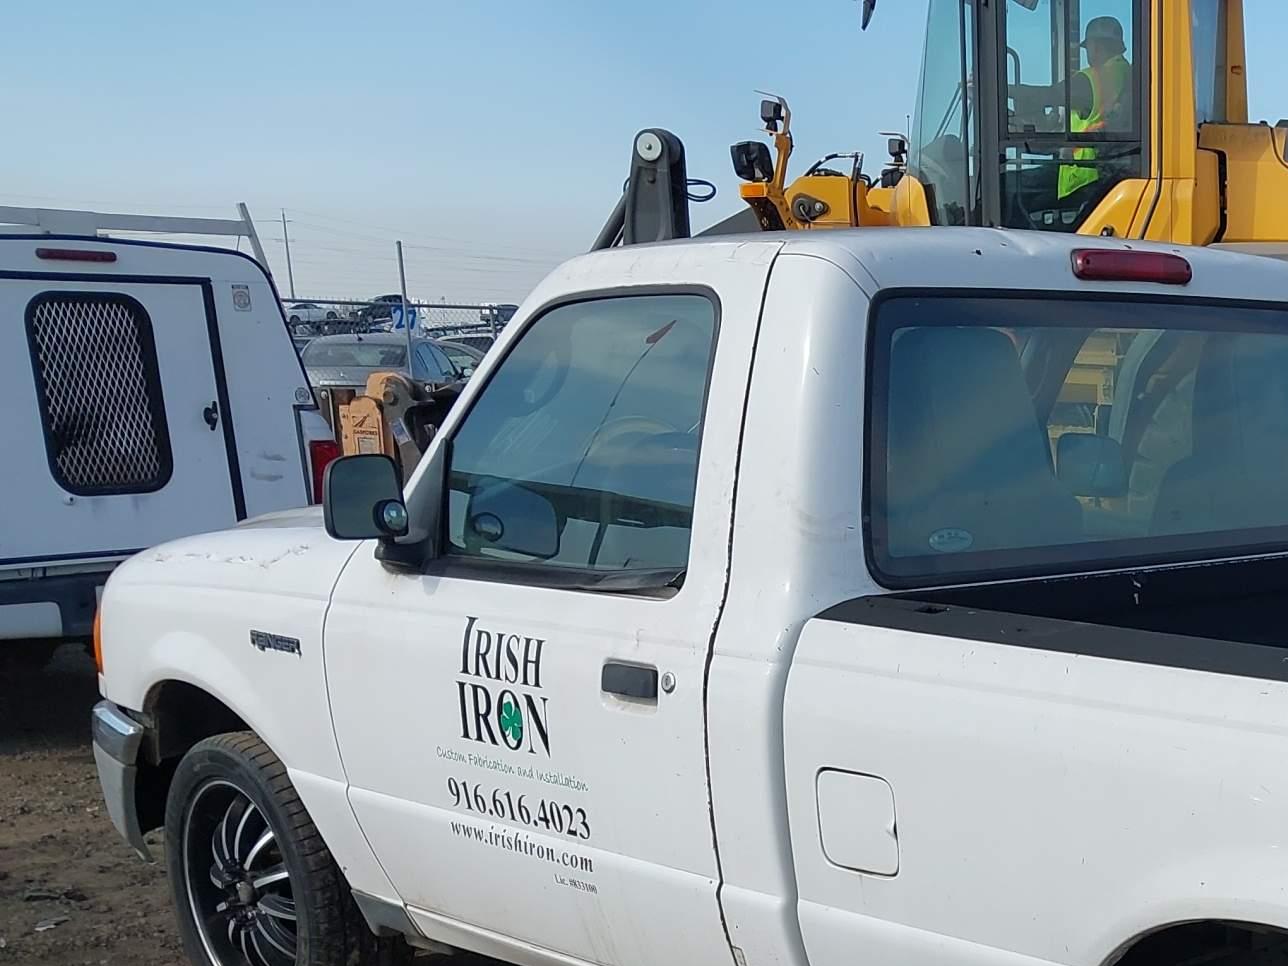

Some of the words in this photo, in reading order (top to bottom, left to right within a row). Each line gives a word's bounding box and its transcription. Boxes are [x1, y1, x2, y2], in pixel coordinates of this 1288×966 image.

[392, 306, 417, 330] 27
[455, 680, 552, 759] IRON
[436, 745, 467, 763] Custom
[468, 753, 515, 775] Fabrication
[517, 765, 535, 778] and
[535, 769, 589, 792] Installation
[448, 777, 591, 840] 916.616.4023
[450, 821, 594, 873] www.irishiron.com
